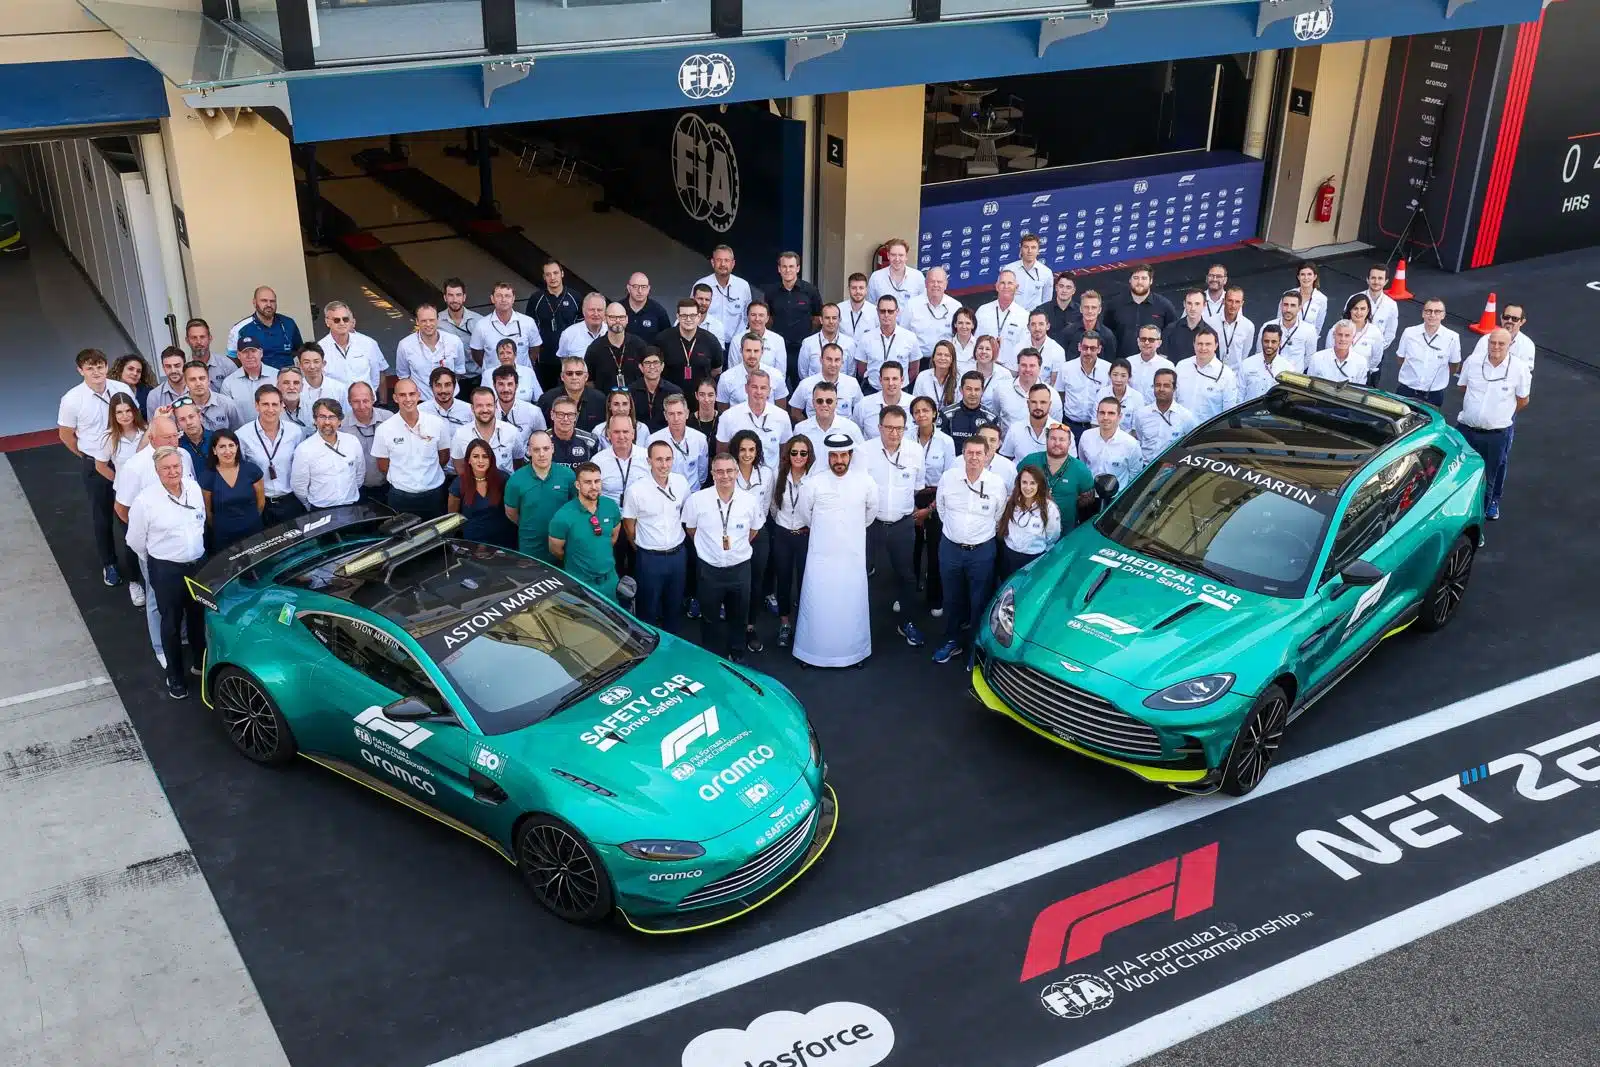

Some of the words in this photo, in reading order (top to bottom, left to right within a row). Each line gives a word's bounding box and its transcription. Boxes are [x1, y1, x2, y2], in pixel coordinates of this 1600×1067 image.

[1425, 79, 1447, 88] aramco
[832, 143, 839, 158] 2
[1562, 194, 1590, 213] HRS
[1178, 454, 1241, 477] ASTON
[1242, 470, 1317, 505] MARTIN
[1117, 553, 1196, 587] MEDICAL
[1201, 584, 1242, 605] CAR
[1121, 564, 1155, 580] Drive
[1156, 576, 1197, 596] Safely
[351, 621, 373, 635] ASTON
[373, 632, 400, 650] MARTIN
[443, 607, 503, 649] ASTON
[500, 577, 565, 612] MARTIN
[580, 695, 652, 745] SAFETY
[650, 674, 693, 698] CAR
[618, 715, 651, 737] Drive
[647, 694, 684, 717] Safely
[360, 749, 437, 796] aramco
[698, 745, 774, 801] aramco
[764, 811, 796, 839] SAFETY
[795, 799, 812, 816] CAR
[1296, 774, 1503, 881] NET
[649, 869, 703, 882] aramco
[1104, 960, 1142, 981] FIA
[1137, 930, 1216, 967] Formula
[1209, 925, 1229, 937] 1
[1116, 961, 1179, 993] World
[1175, 913, 1301, 969] Championship
